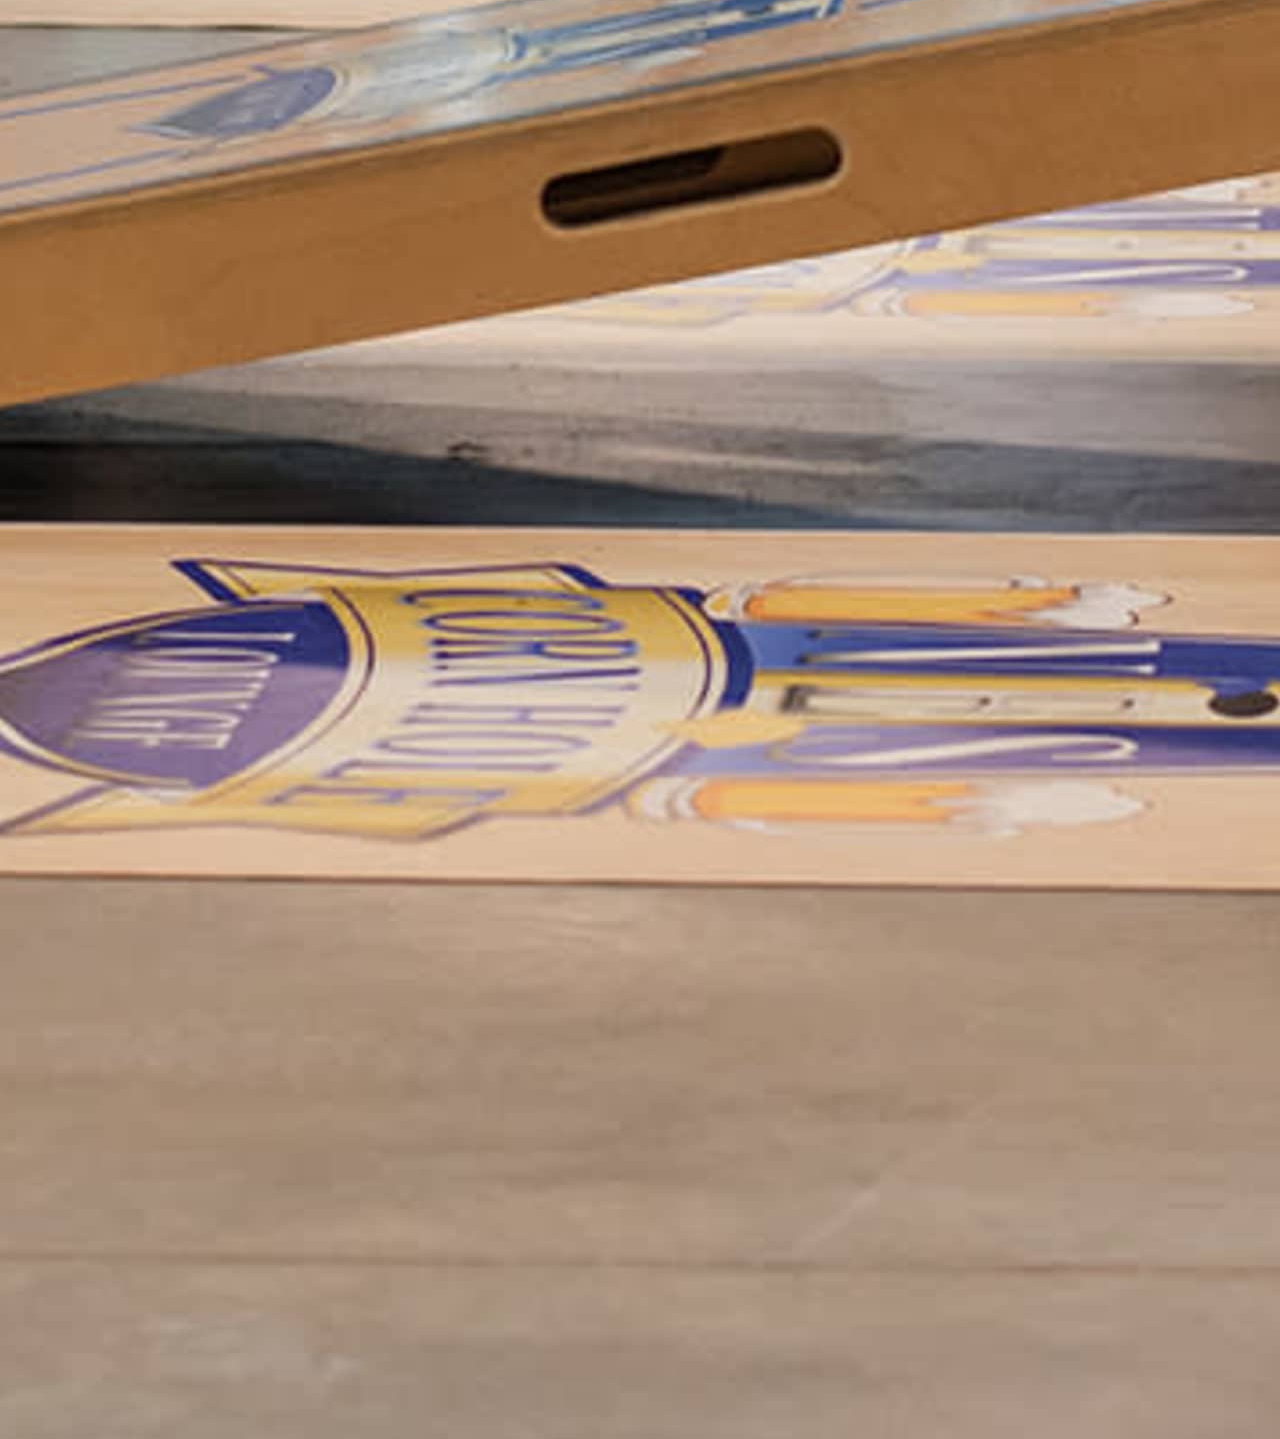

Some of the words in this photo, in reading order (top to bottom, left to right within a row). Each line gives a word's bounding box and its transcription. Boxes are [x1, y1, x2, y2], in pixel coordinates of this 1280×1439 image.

[70, 631, 297, 750] LOUNGE
[398, 587, 642, 695] CORN
[263, 703, 628, 806] HOLE
